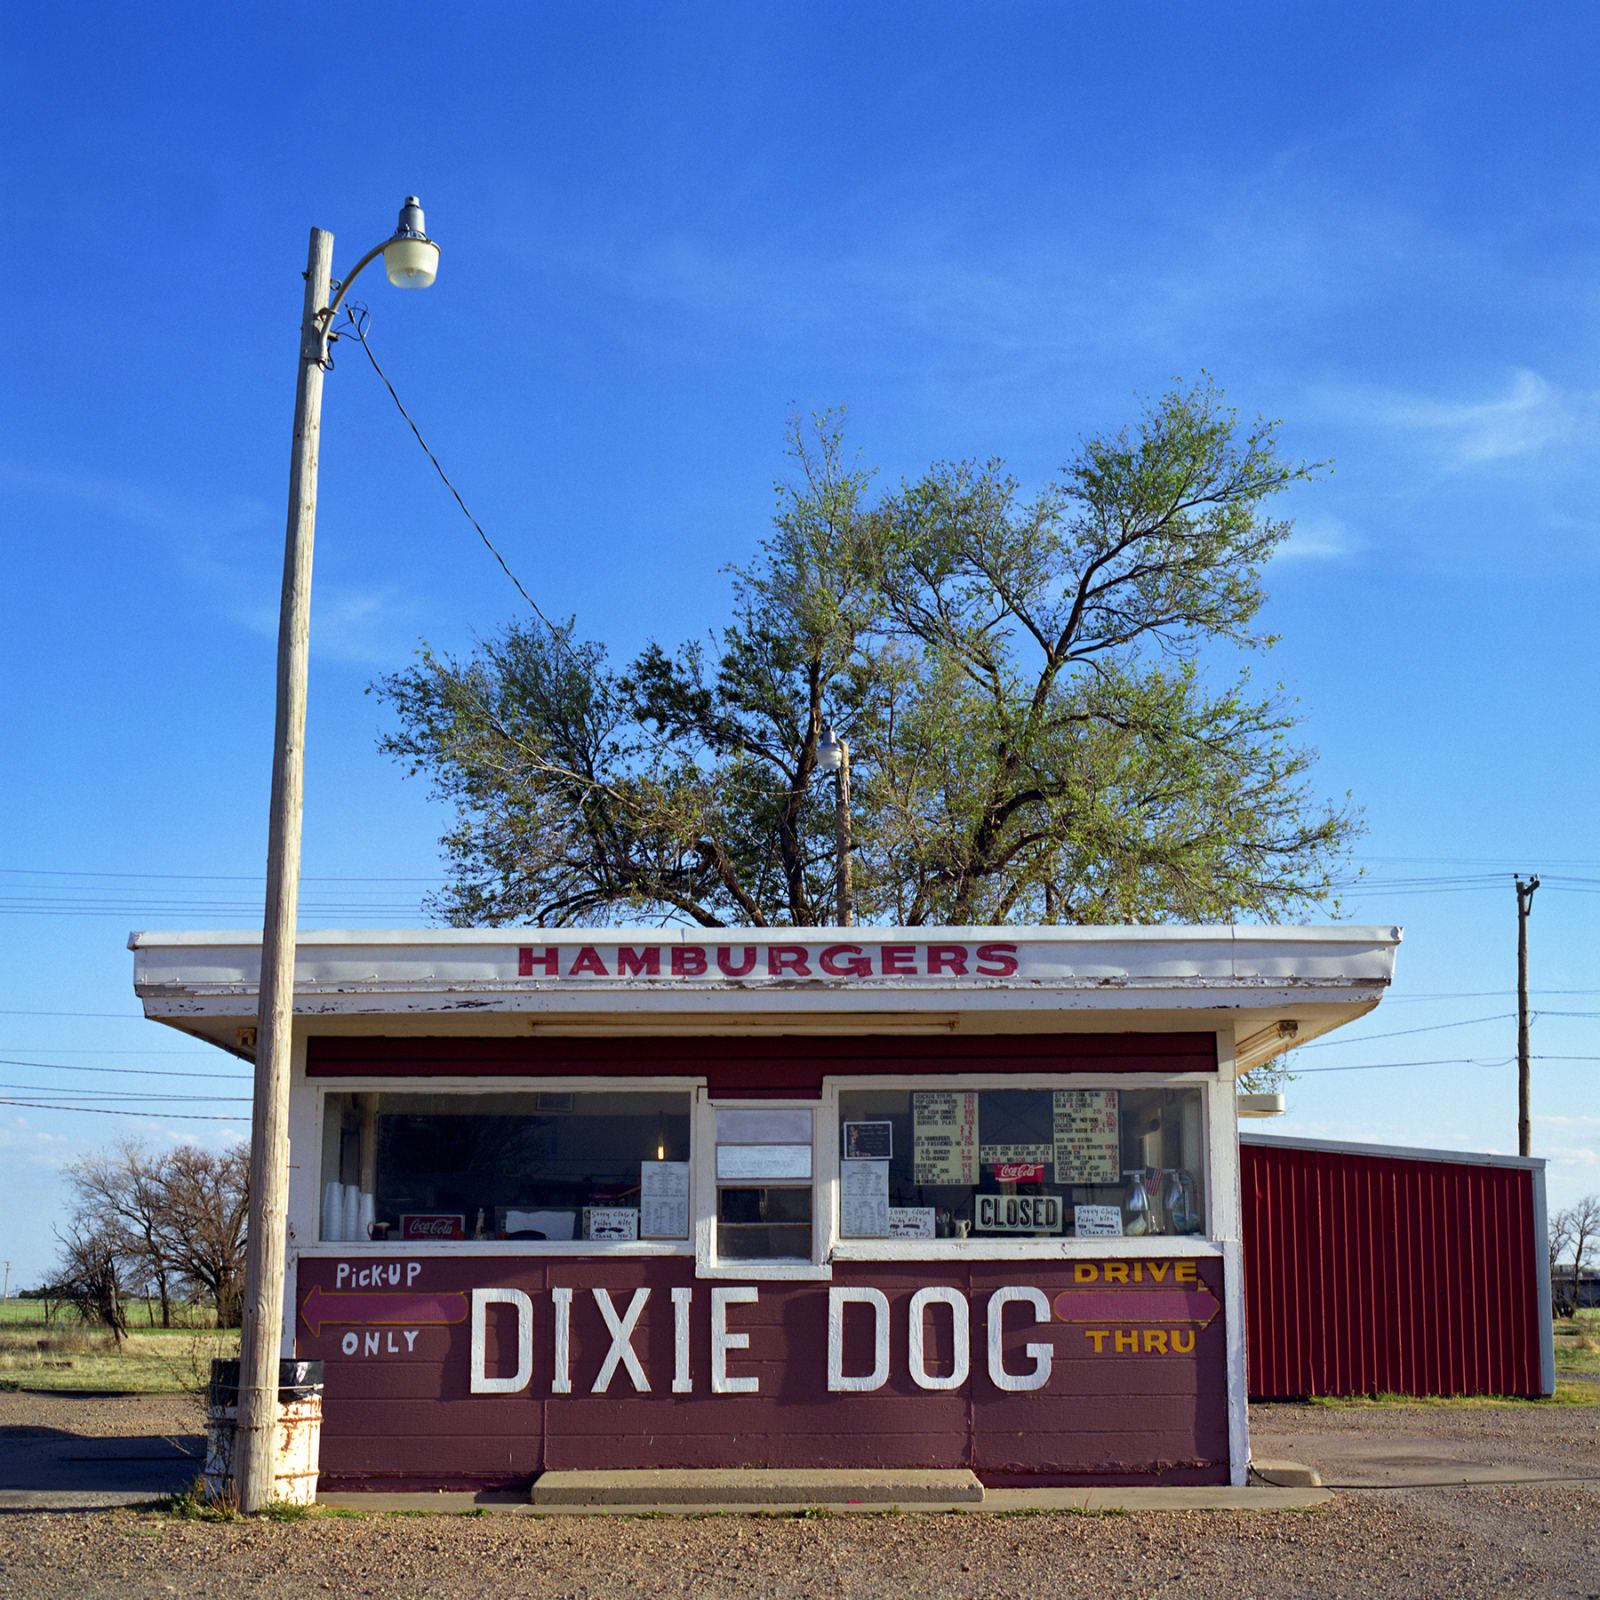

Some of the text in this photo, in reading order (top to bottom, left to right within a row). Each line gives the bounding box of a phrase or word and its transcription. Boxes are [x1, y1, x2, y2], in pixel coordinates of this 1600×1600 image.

[518, 944, 1018, 977] HAMBURGERS
[981, 1198, 1058, 1228] CLOSED
[410, 1219, 455, 1234] Coca-Cola
[1073, 1262, 1197, 1283] DRIVE
[342, 1330, 419, 1356] ONLY
[470, 1286, 1054, 1395] DIXIE DOG
[1085, 1329, 1196, 1355] THRU
